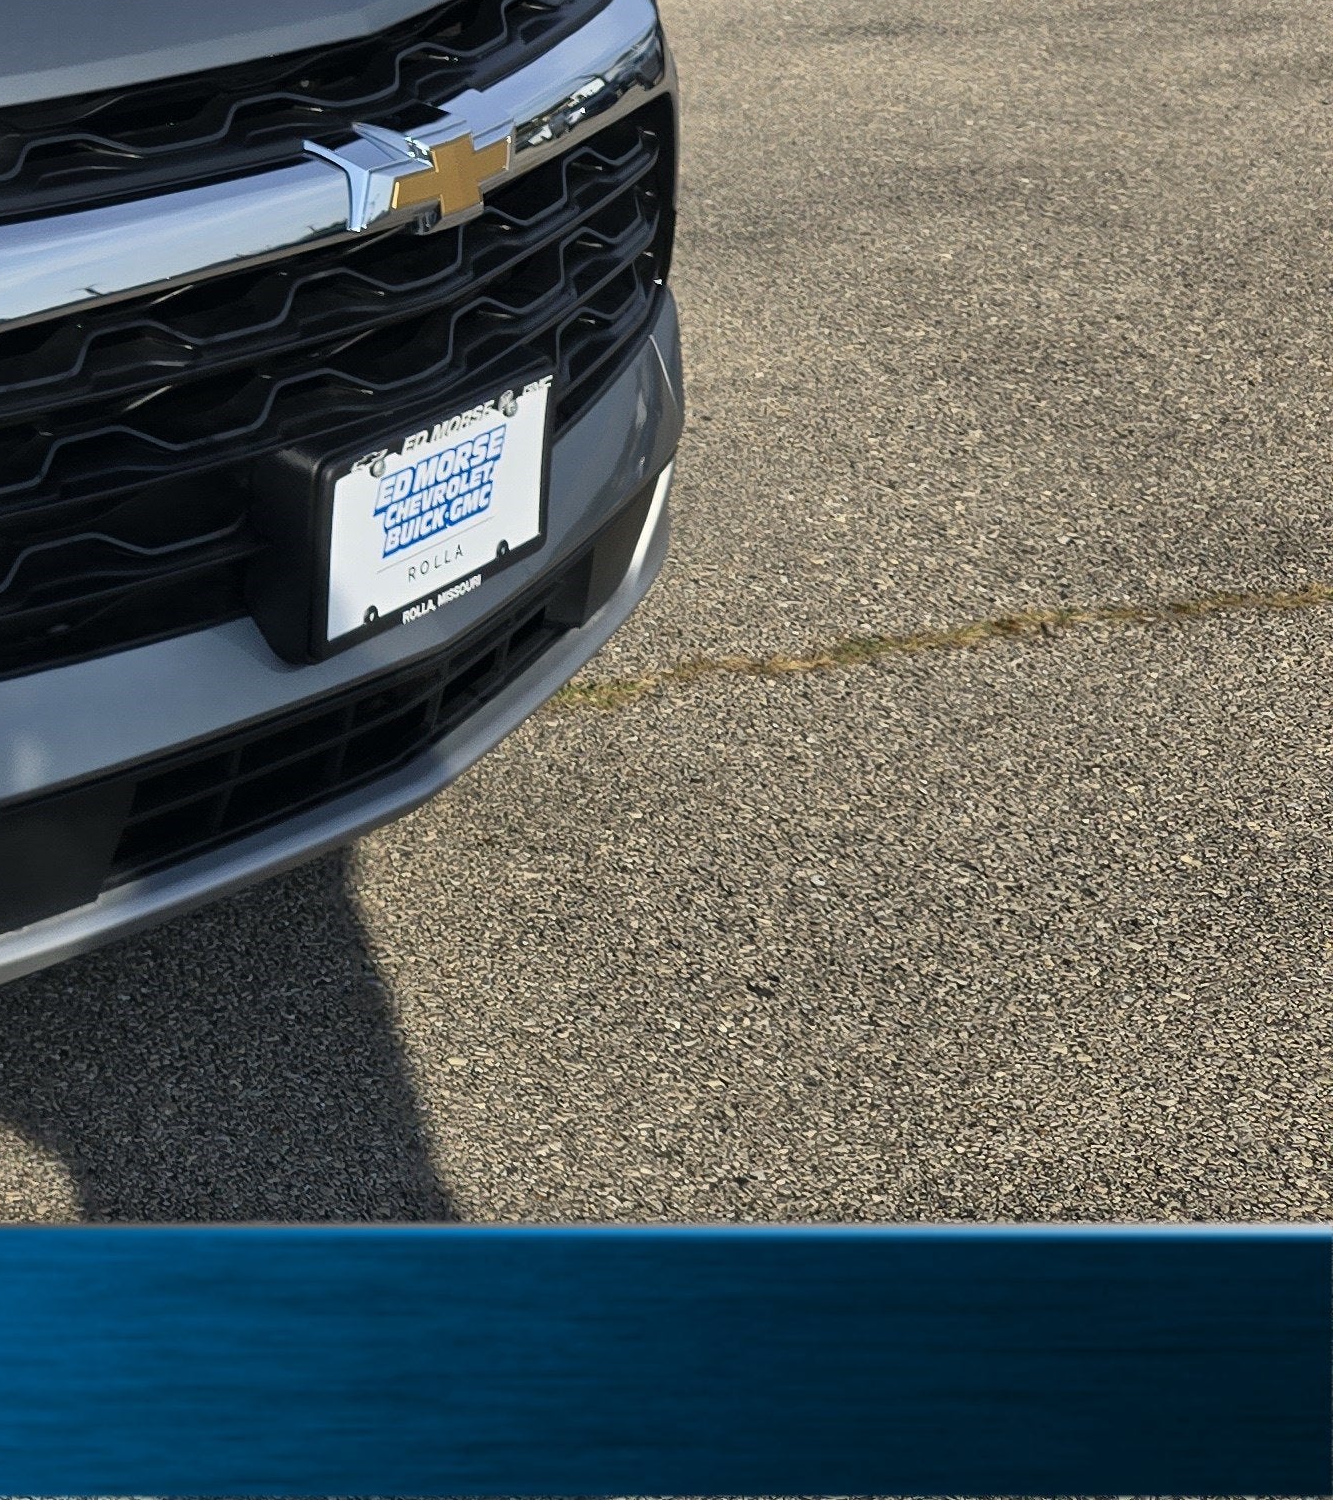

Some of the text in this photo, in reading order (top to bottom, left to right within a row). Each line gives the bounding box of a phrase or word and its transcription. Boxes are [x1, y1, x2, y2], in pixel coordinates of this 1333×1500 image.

[402, 430, 428, 454] ED
[431, 400, 495, 441] MORSE
[374, 424, 506, 515] ED MORSE
[384, 460, 495, 529] CHEVROLET
[408, 544, 464, 582] ROLLA
[437, 574, 482, 607] MISSOURI
